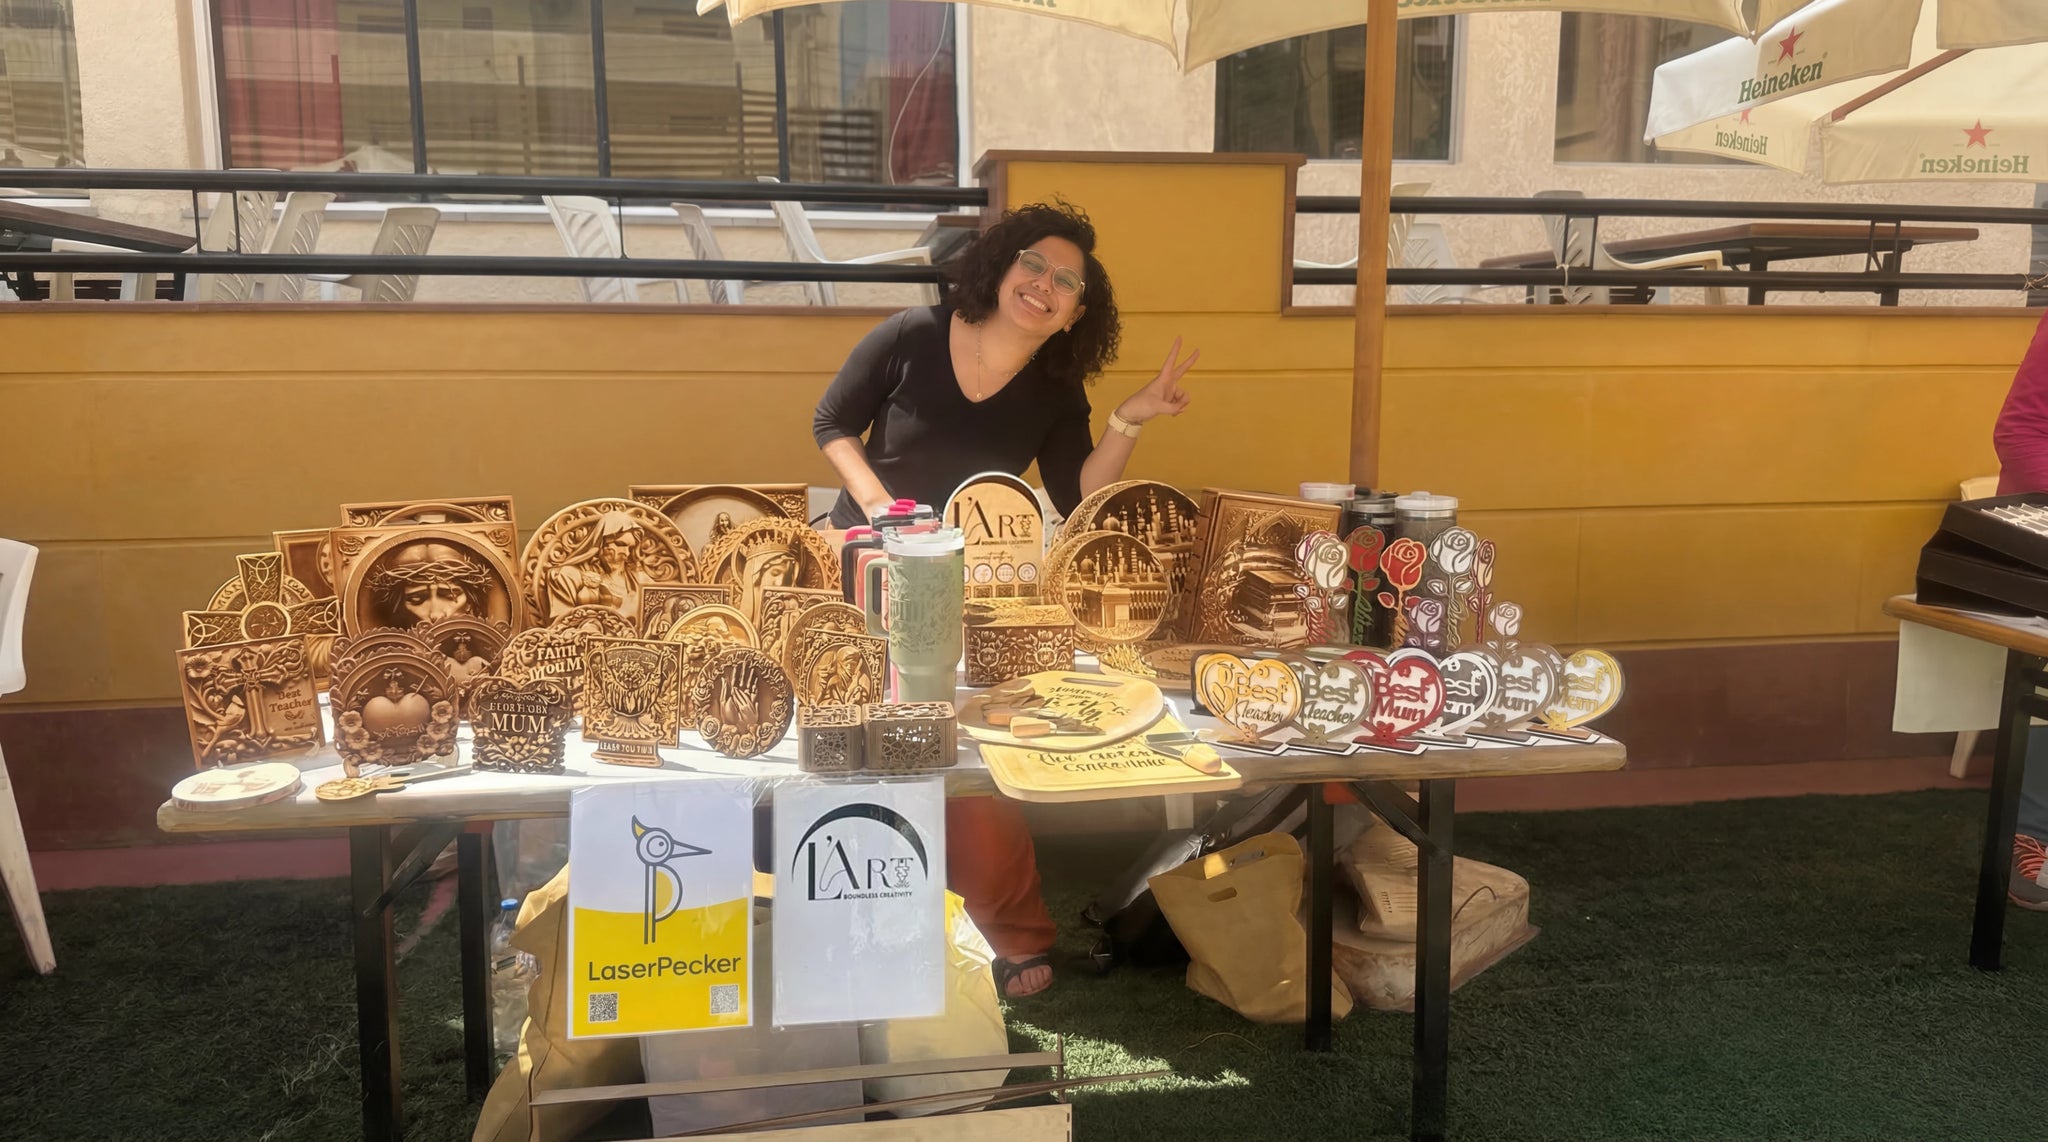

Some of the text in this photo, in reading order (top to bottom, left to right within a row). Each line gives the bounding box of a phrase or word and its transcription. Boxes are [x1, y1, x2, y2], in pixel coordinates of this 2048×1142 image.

[1738, 61, 1823, 104] Heineken
[1235, 672, 1287, 704] Best
[1305, 675, 1358, 704] Best
[1374, 671, 1430, 703] Best
[1444, 670, 1480, 697] est
[491, 712, 547, 734] MUM
[1303, 700, 1354, 724] Teacher
[588, 953, 742, 981] LaserPecker
